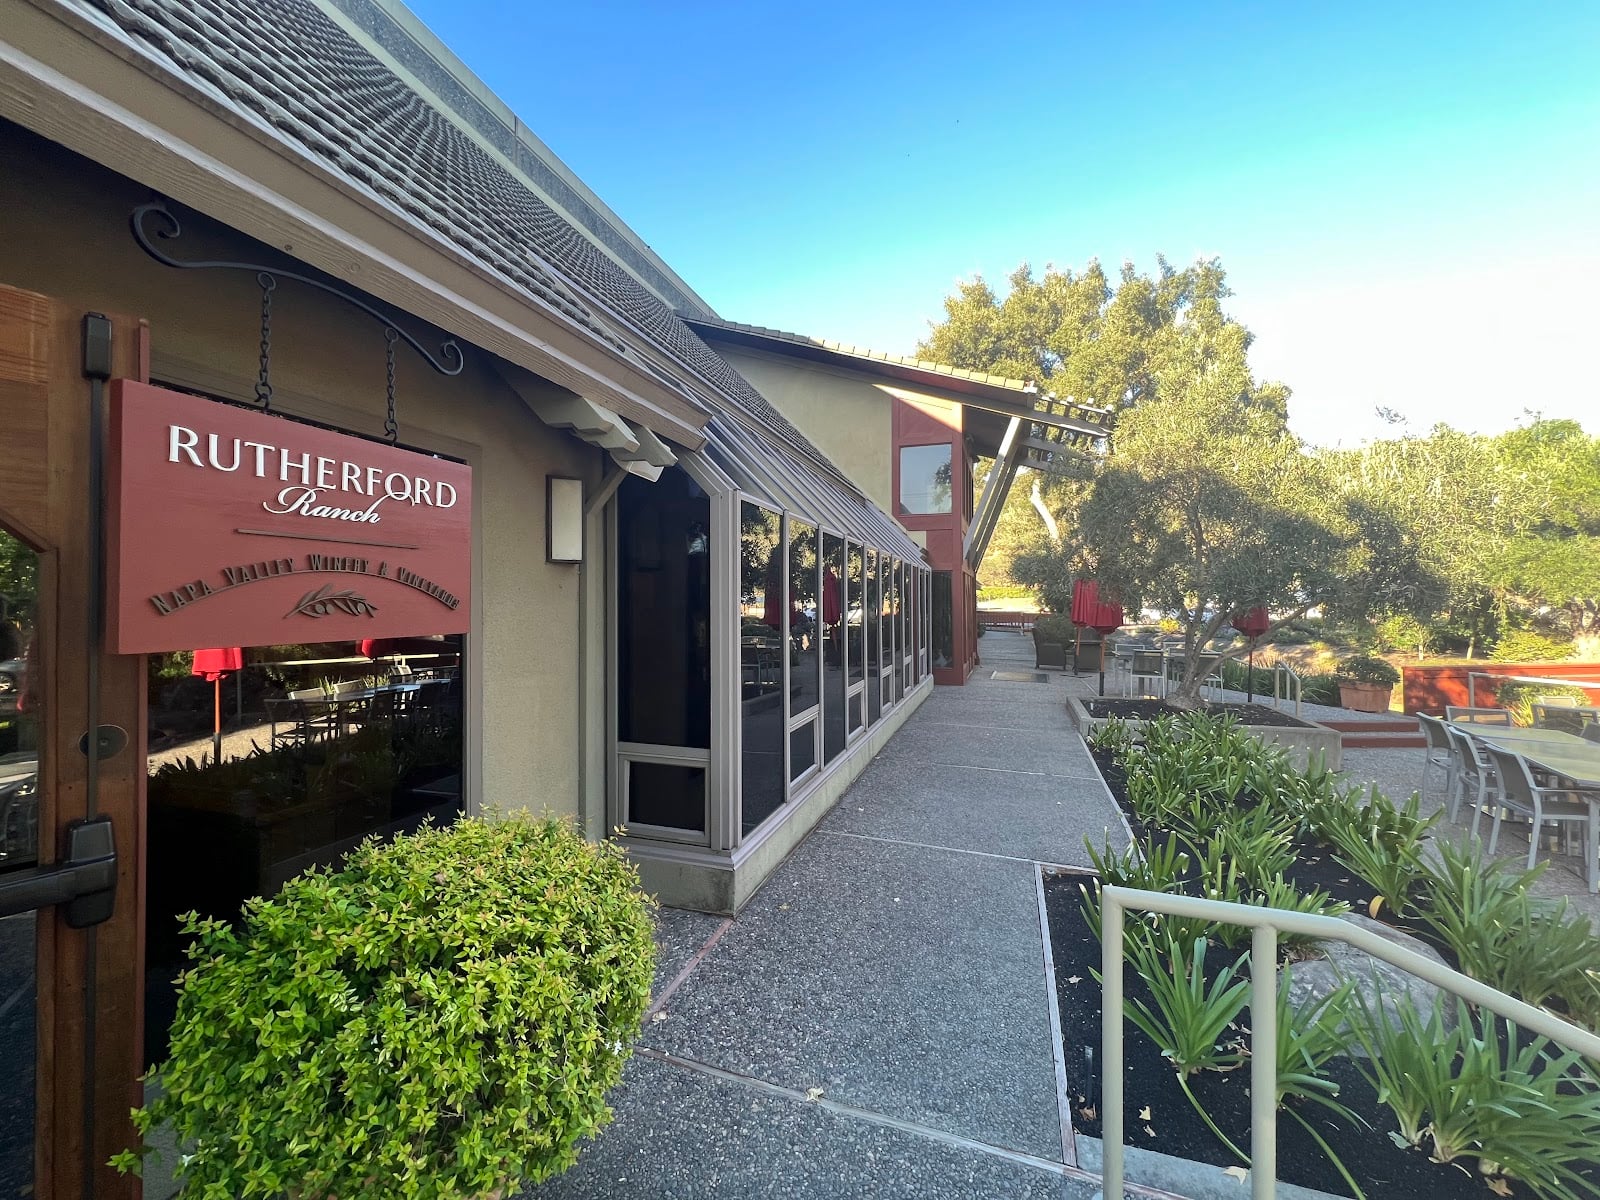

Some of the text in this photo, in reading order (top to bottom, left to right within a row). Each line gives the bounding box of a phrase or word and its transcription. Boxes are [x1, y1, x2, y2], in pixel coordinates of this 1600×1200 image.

[168, 424, 457, 508] RUTHERFORD
[263, 486, 414, 524] Ranch
[151, 579, 214, 616] NAPA
[222, 557, 296, 586] VALLEY
[309, 553, 369, 573] WINERY
[380, 561, 388, 576] &
